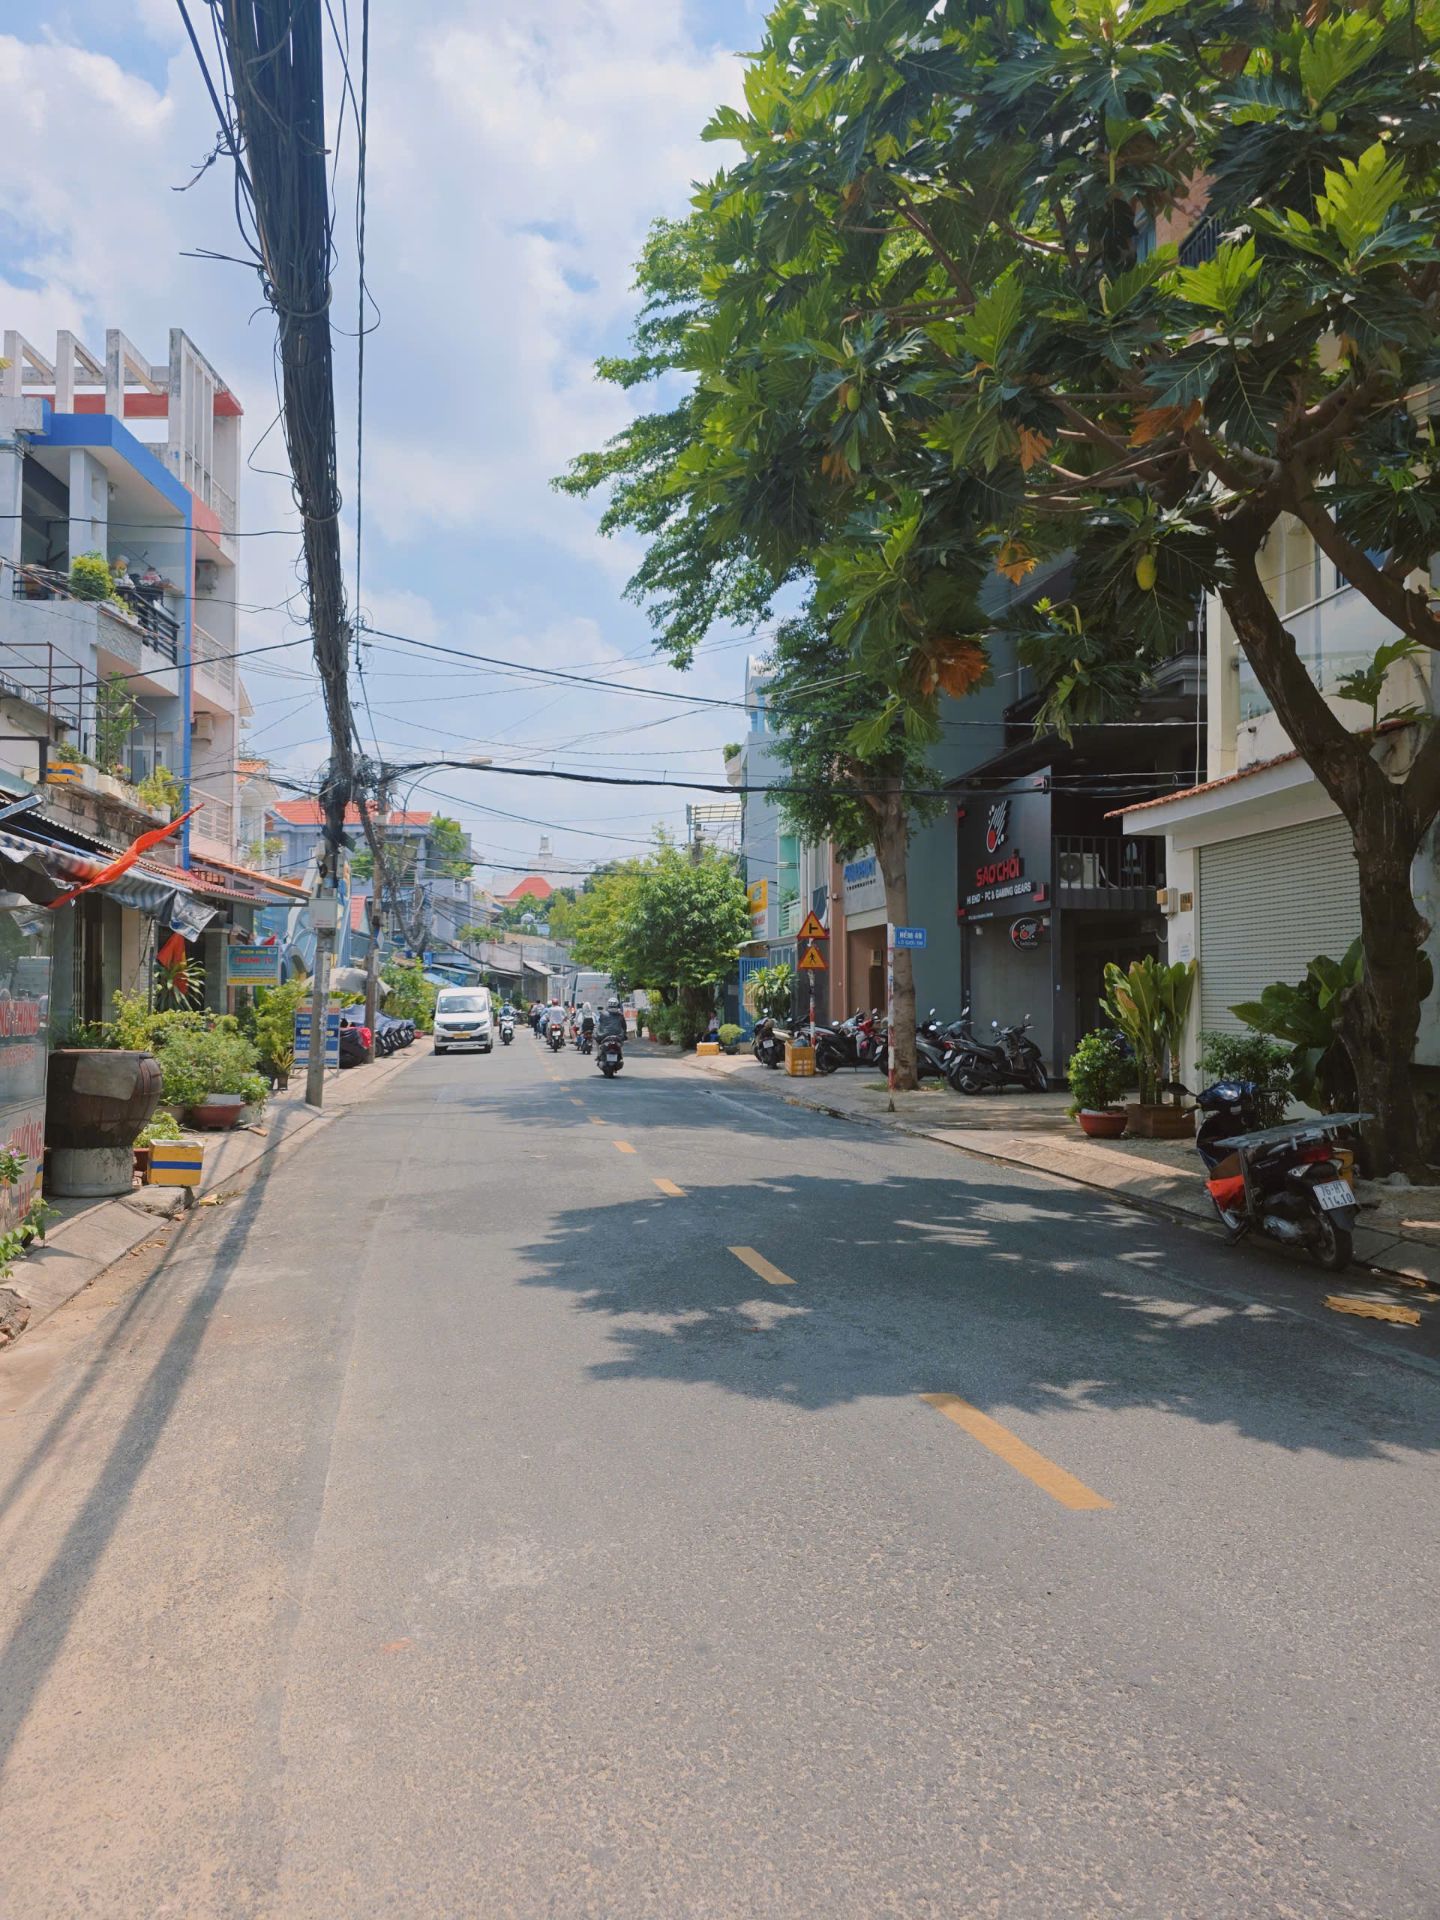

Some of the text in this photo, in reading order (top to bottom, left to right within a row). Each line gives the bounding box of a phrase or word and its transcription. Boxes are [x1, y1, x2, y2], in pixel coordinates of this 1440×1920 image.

[976, 864, 996, 887] SAO
[995, 886, 1014, 899] GAMING
[1014, 882, 1032, 895] GEARS
